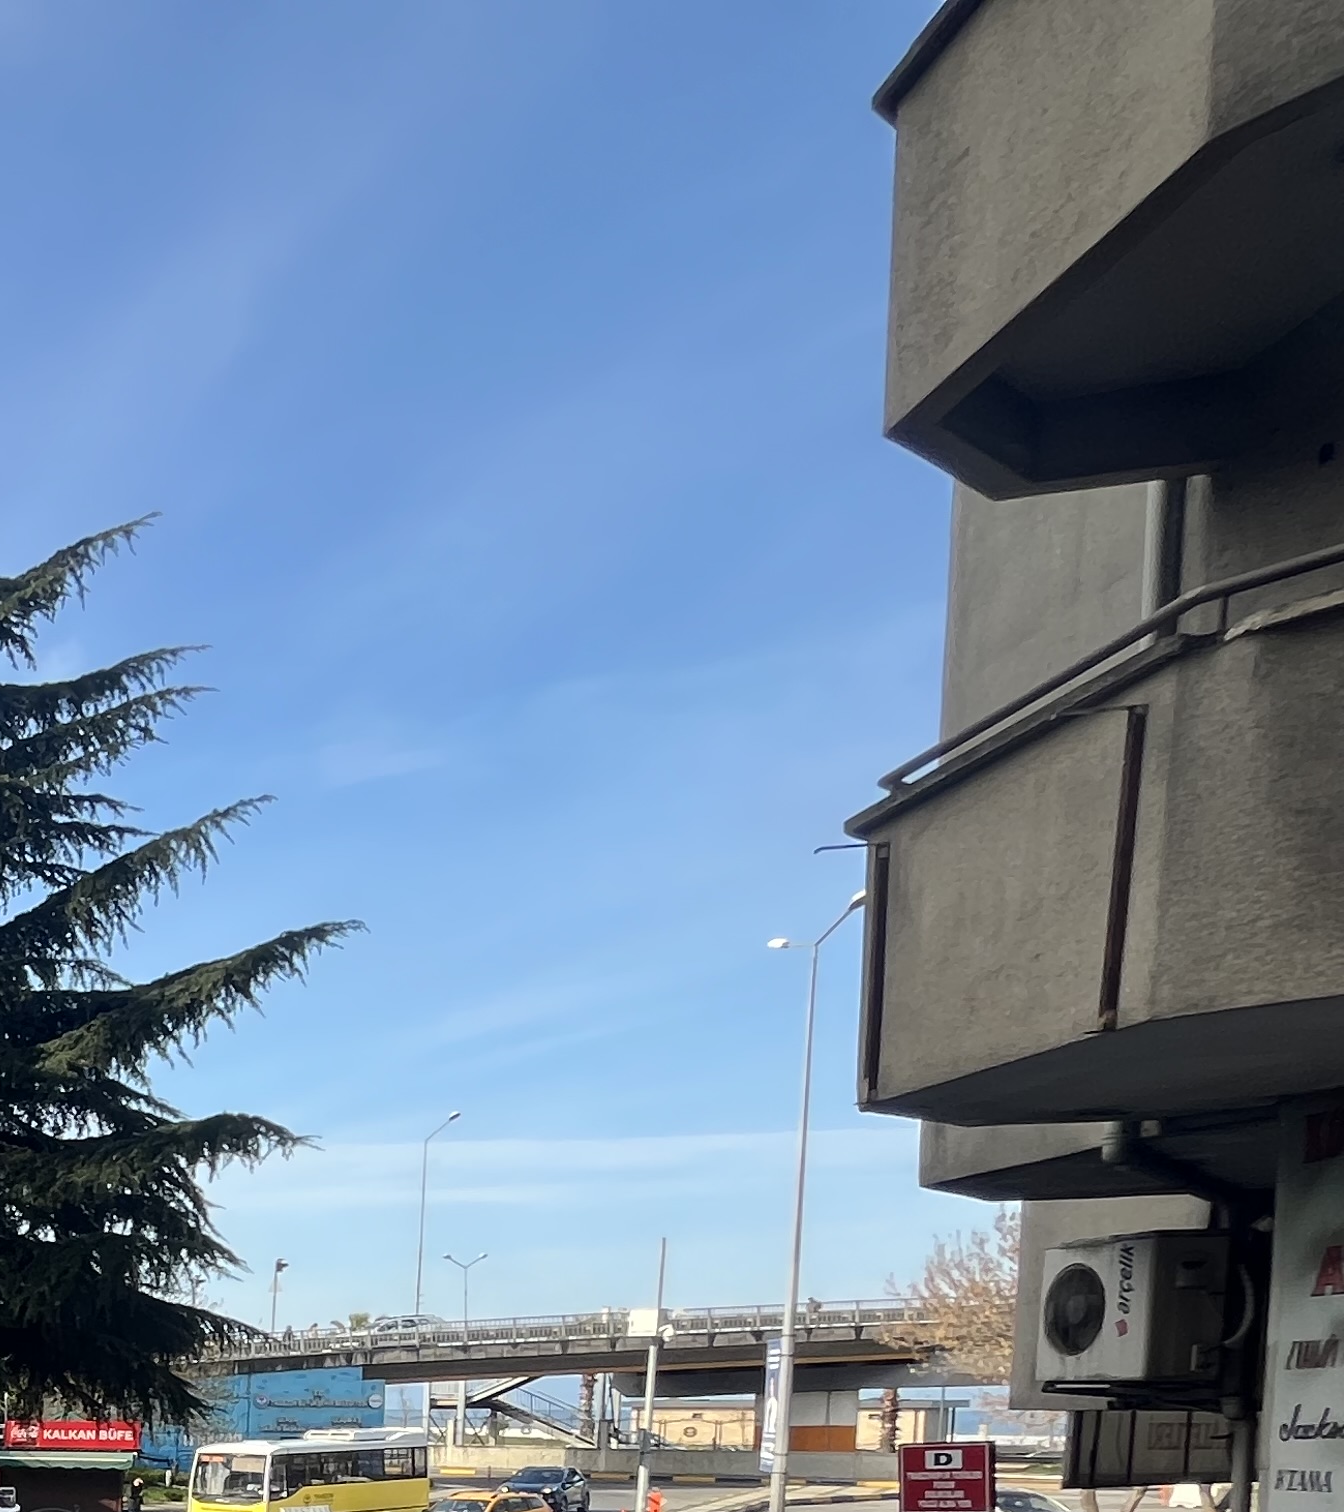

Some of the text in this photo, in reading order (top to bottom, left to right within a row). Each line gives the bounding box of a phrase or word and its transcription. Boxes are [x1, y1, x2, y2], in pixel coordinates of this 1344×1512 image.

[1116, 1243, 1135, 1315] arçelik
[43, 1427, 134, 1441] KALKAN BÜFE
[933, 1452, 953, 1467] D
